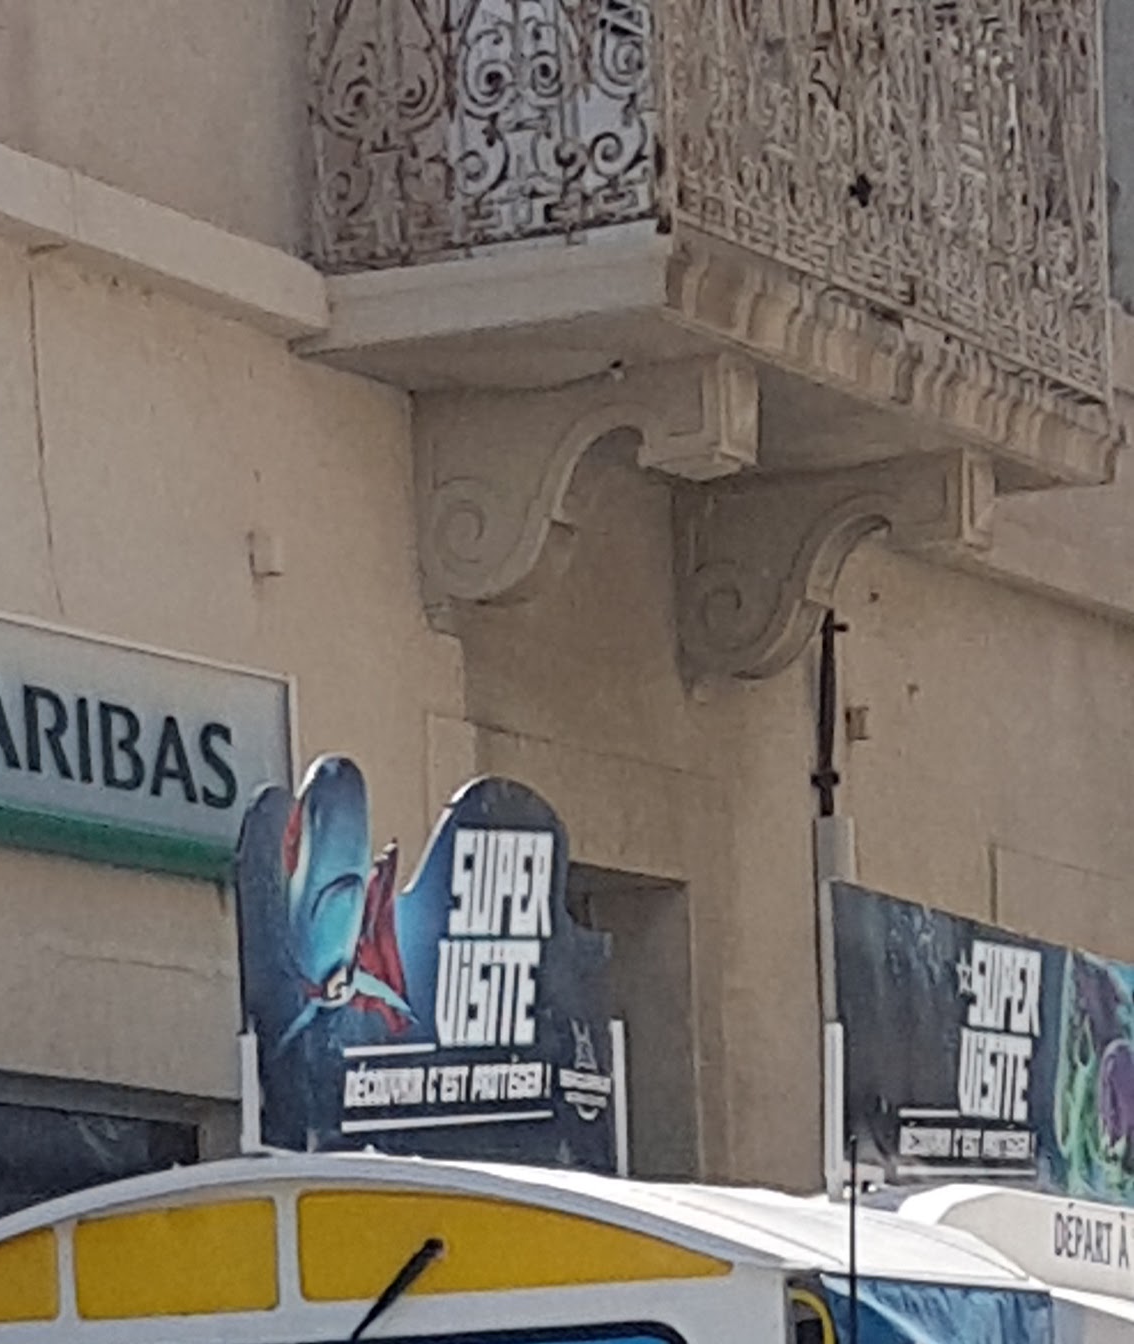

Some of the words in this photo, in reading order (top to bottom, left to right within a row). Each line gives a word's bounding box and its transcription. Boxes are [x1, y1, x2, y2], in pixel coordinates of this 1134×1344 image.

[449, 829, 555, 938] SUPER
[968, 939, 1042, 1038] SUPER
[1053, 1202, 1114, 1266] DÉPART
[1118, 1211, 1130, 1270] À
